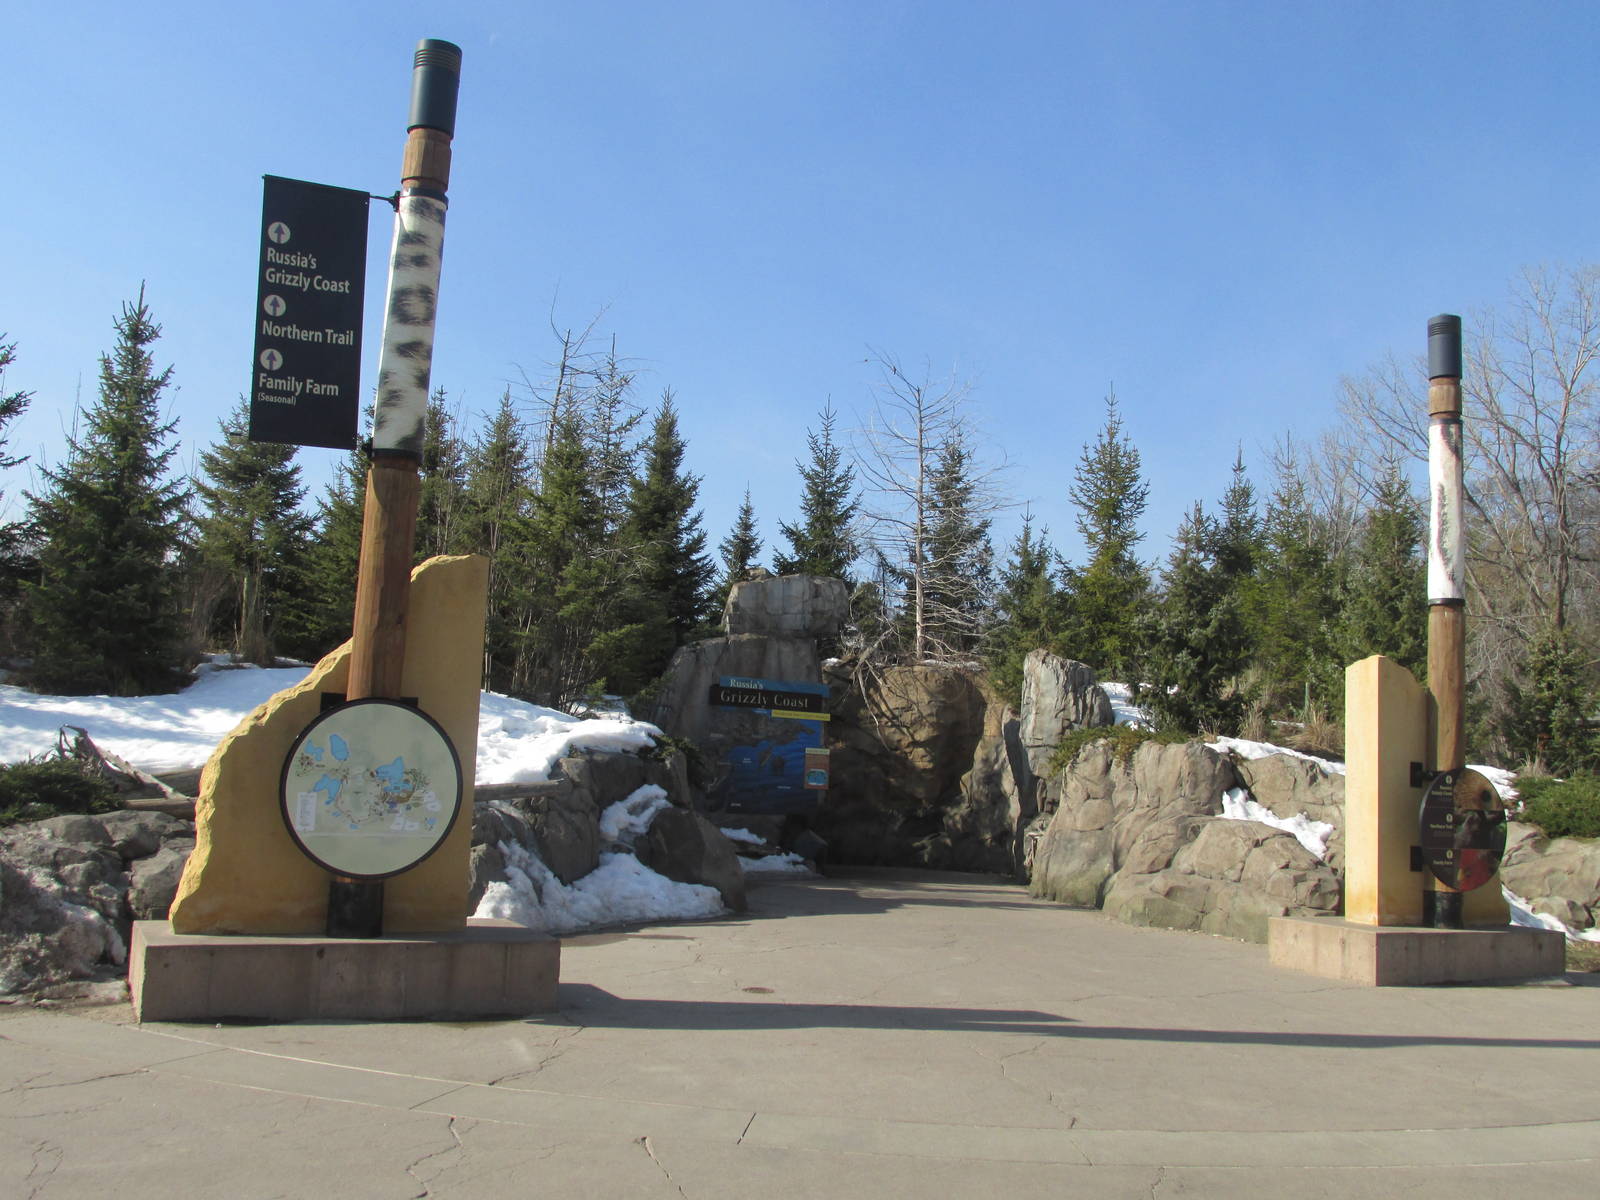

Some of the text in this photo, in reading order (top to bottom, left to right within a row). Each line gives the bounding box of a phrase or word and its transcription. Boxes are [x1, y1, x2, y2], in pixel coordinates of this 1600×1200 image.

[267, 247, 317, 270] Russia's
[265, 268, 351, 294] Grizzly Coast
[262, 320, 354, 346] Northern Trail
[259, 373, 339, 397] Family Farm
[258, 392, 297, 406] (Seasonal)
[729, 679, 764, 689] Russia's
[720, 689, 809, 708] Grizzly Coast
